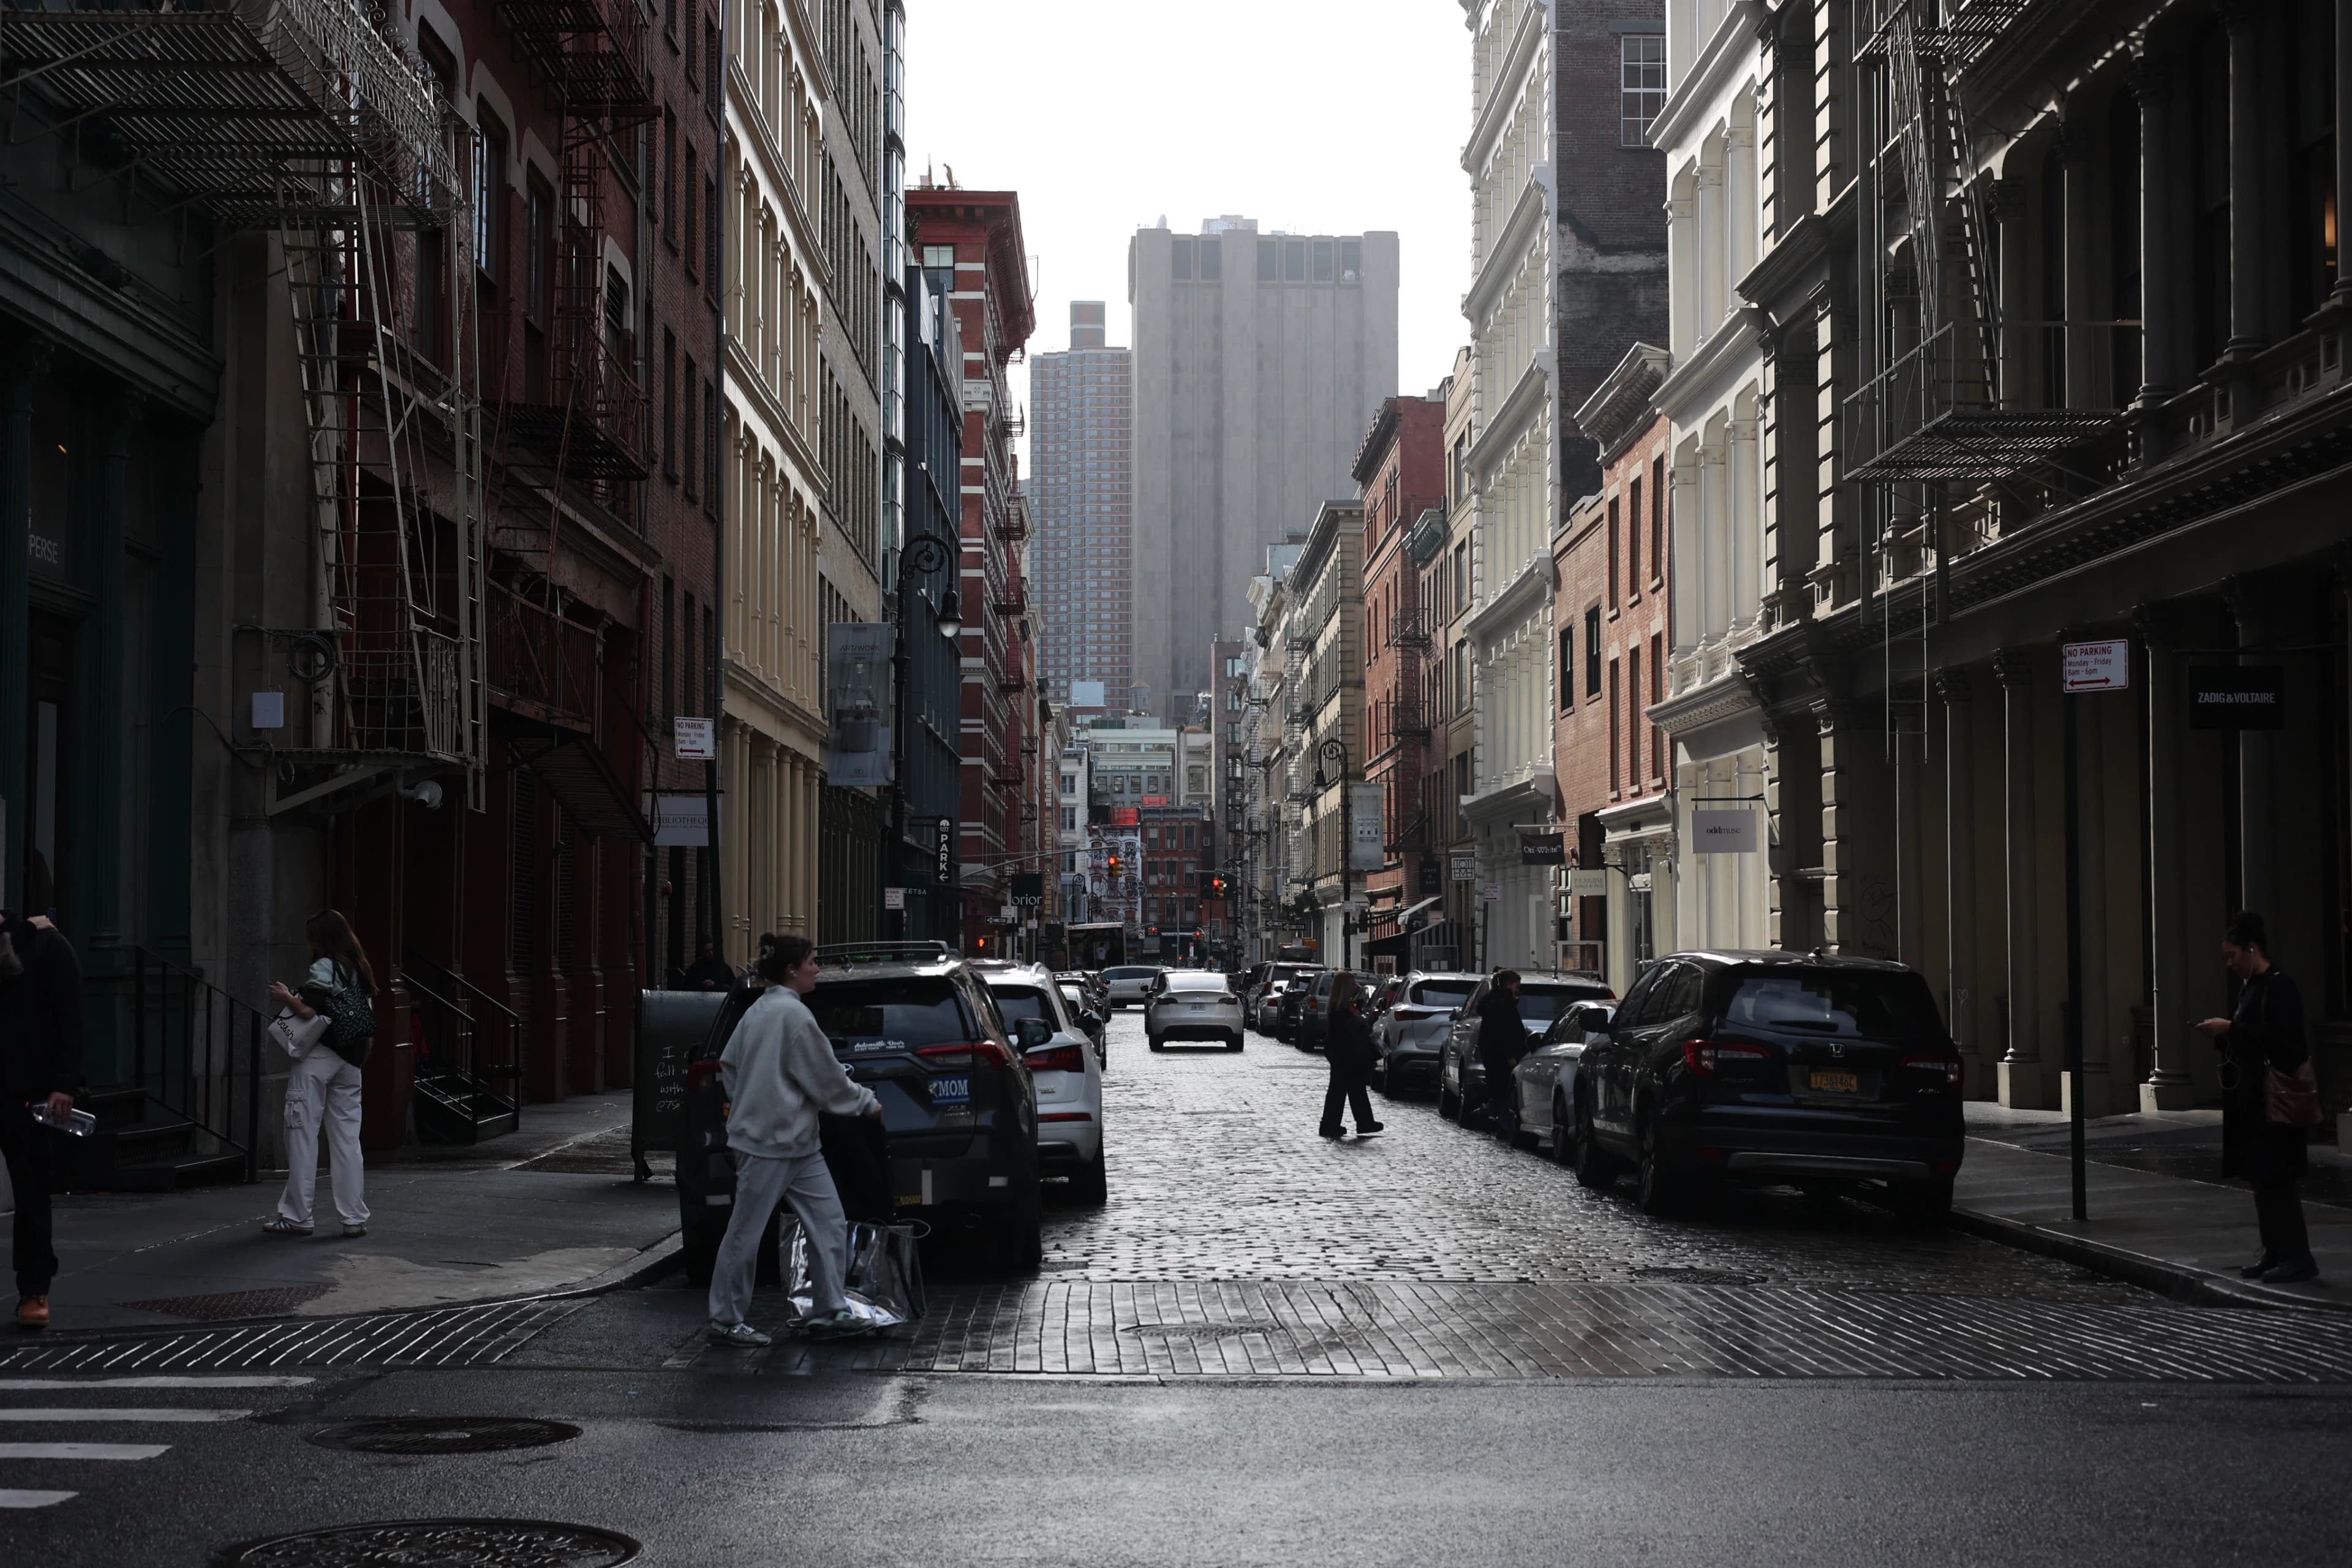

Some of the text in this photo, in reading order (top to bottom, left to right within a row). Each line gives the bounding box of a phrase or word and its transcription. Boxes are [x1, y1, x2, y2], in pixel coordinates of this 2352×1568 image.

[29, 533, 58, 564] PERSE
[2068, 646, 2112, 657] NO PARKING
[940, 834, 949, 871] PARK
[1012, 893, 1042, 905] orior
[662, 1045, 675, 1058] I
[660, 1080, 684, 1096] with
[938, 1079, 969, 1097] MOM
